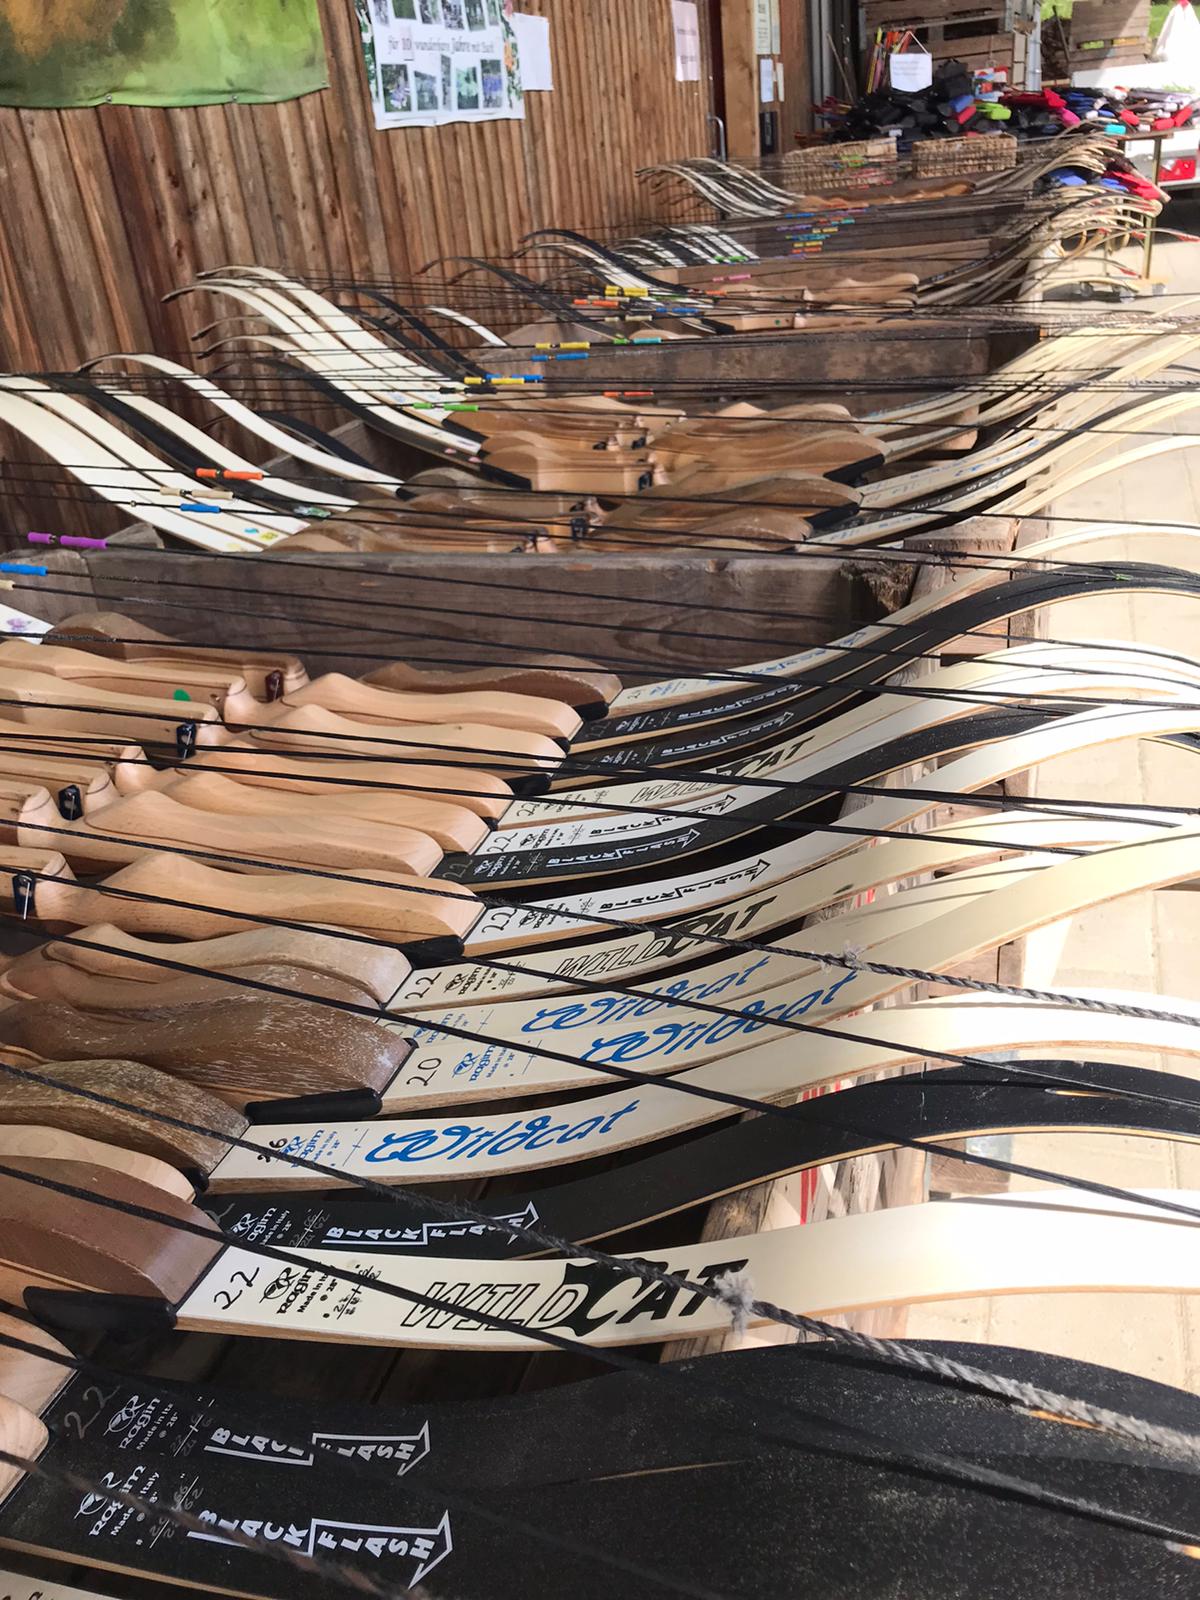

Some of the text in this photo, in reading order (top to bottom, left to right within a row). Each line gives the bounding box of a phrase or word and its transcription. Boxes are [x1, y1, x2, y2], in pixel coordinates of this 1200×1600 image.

[600, 889, 678, 910] BLACK
[547, 895, 778, 982] WILDCAT
[404, 971, 442, 999] 22
[406, 1057, 442, 1087] 20
[364, 1100, 639, 1163] Wildcat
[325, 1226, 421, 1241] BLACK
[213, 1266, 260, 1310] 22
[399, 1256, 749, 1338] WILDCAT
[63, 1385, 121, 1439] 22
[140, 1472, 160, 1494] Italy
[198, 1509, 309, 1547] BLACK
[317, 1531, 435, 1560] FLASH
